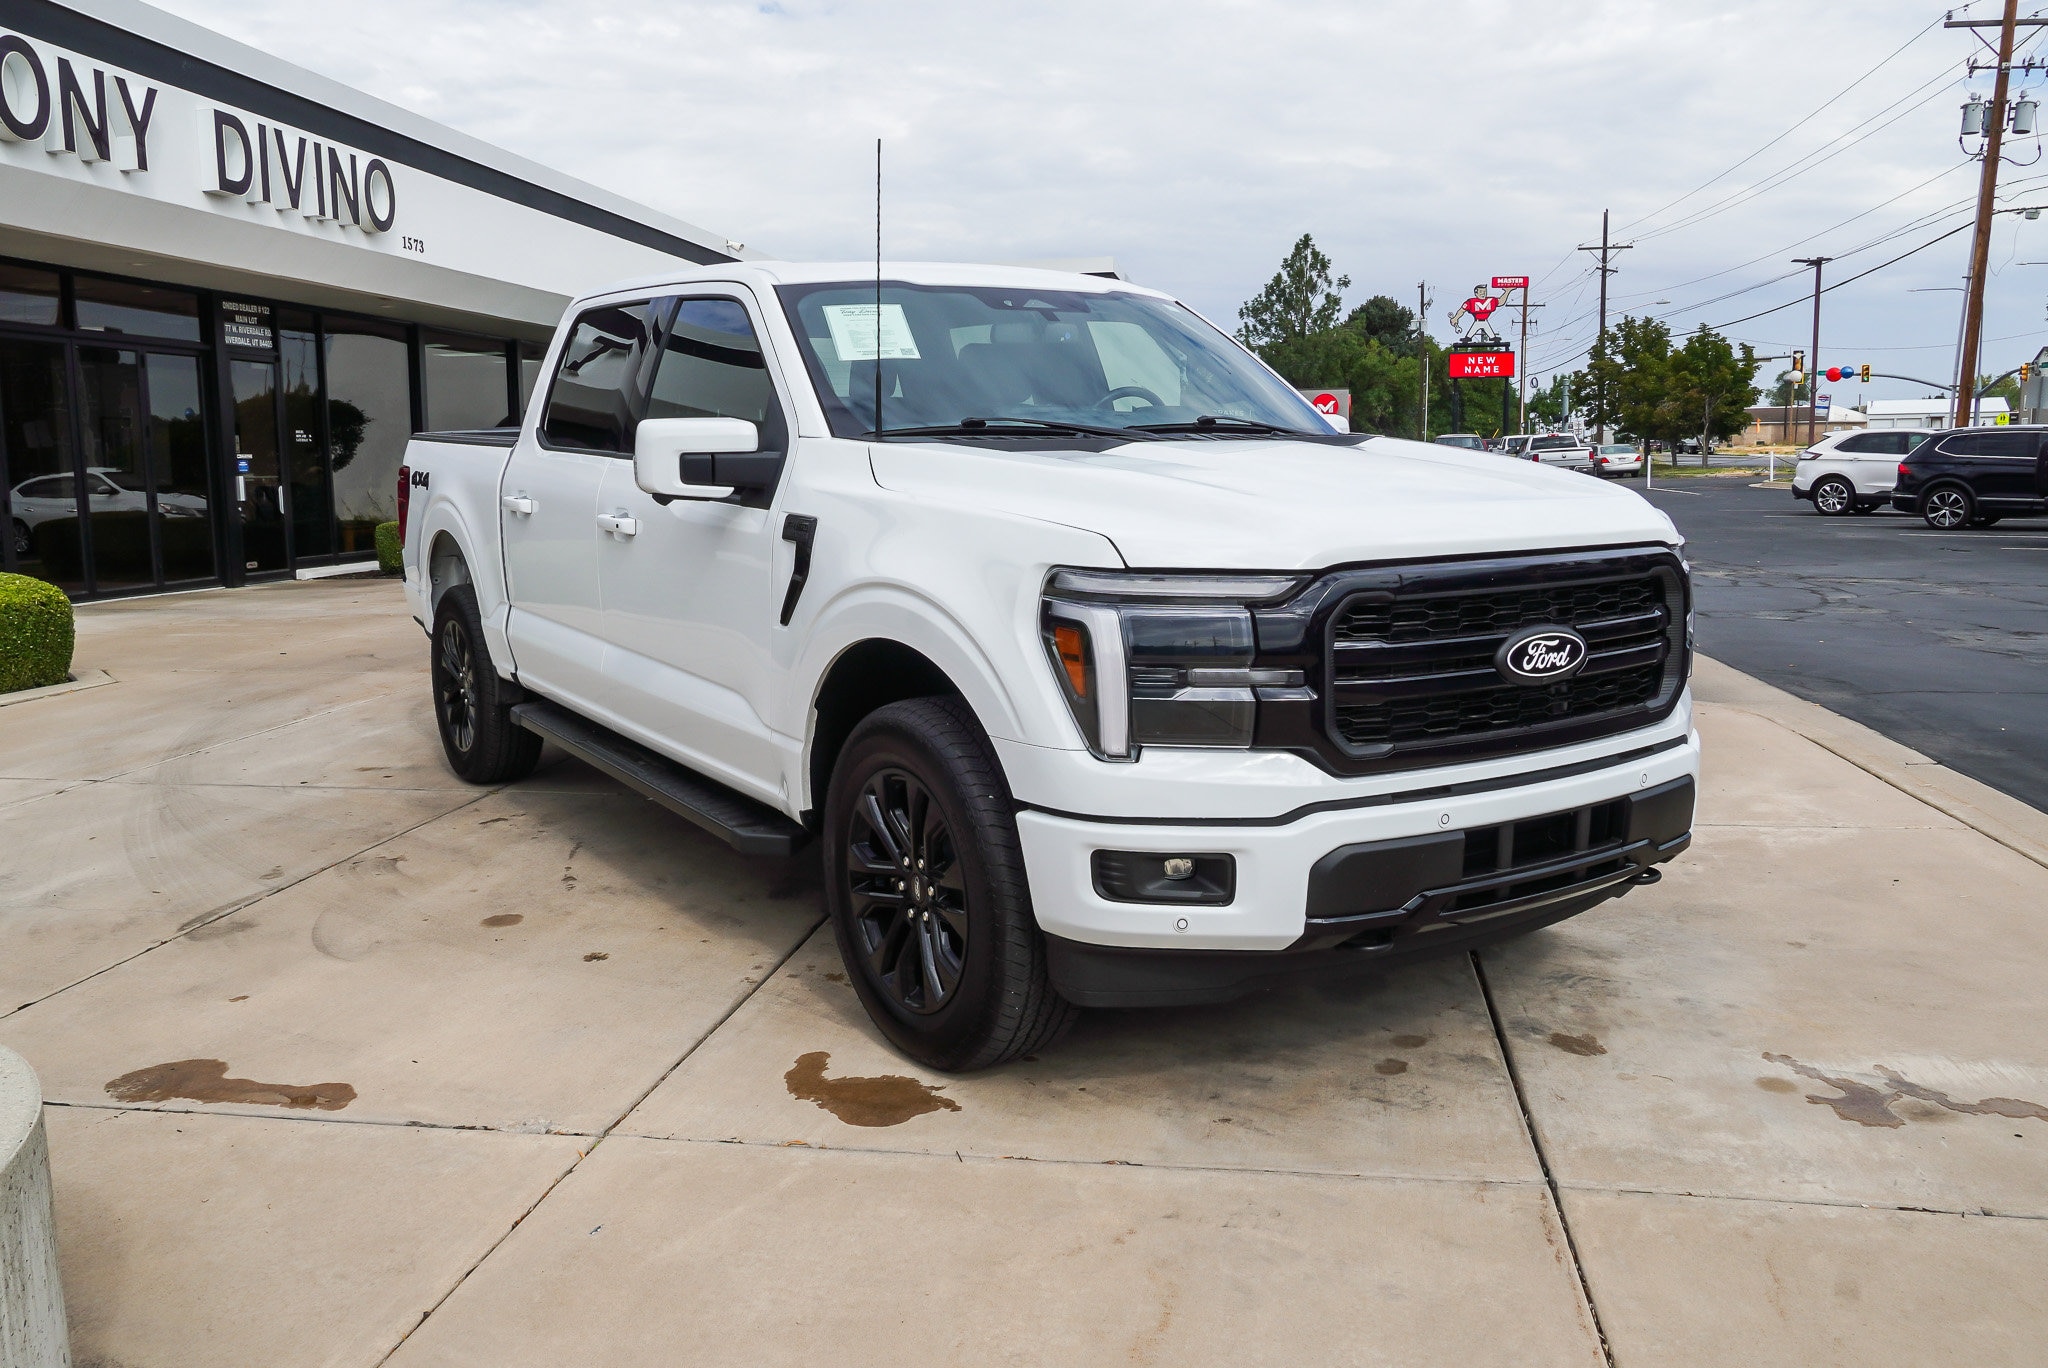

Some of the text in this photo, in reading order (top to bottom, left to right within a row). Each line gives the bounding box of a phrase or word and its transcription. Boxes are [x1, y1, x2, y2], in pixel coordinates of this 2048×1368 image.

[212, 108, 396, 234] DIVINO
[402, 236, 425, 254] 1573
[235, 314, 258, 325] MAIN LOT
[238, 326, 264, 336] RIVERDALE
[1468, 356, 1496, 364] NEW
[1464, 365, 1500, 373] NAME
[1522, 639, 1571, 671] Ford
